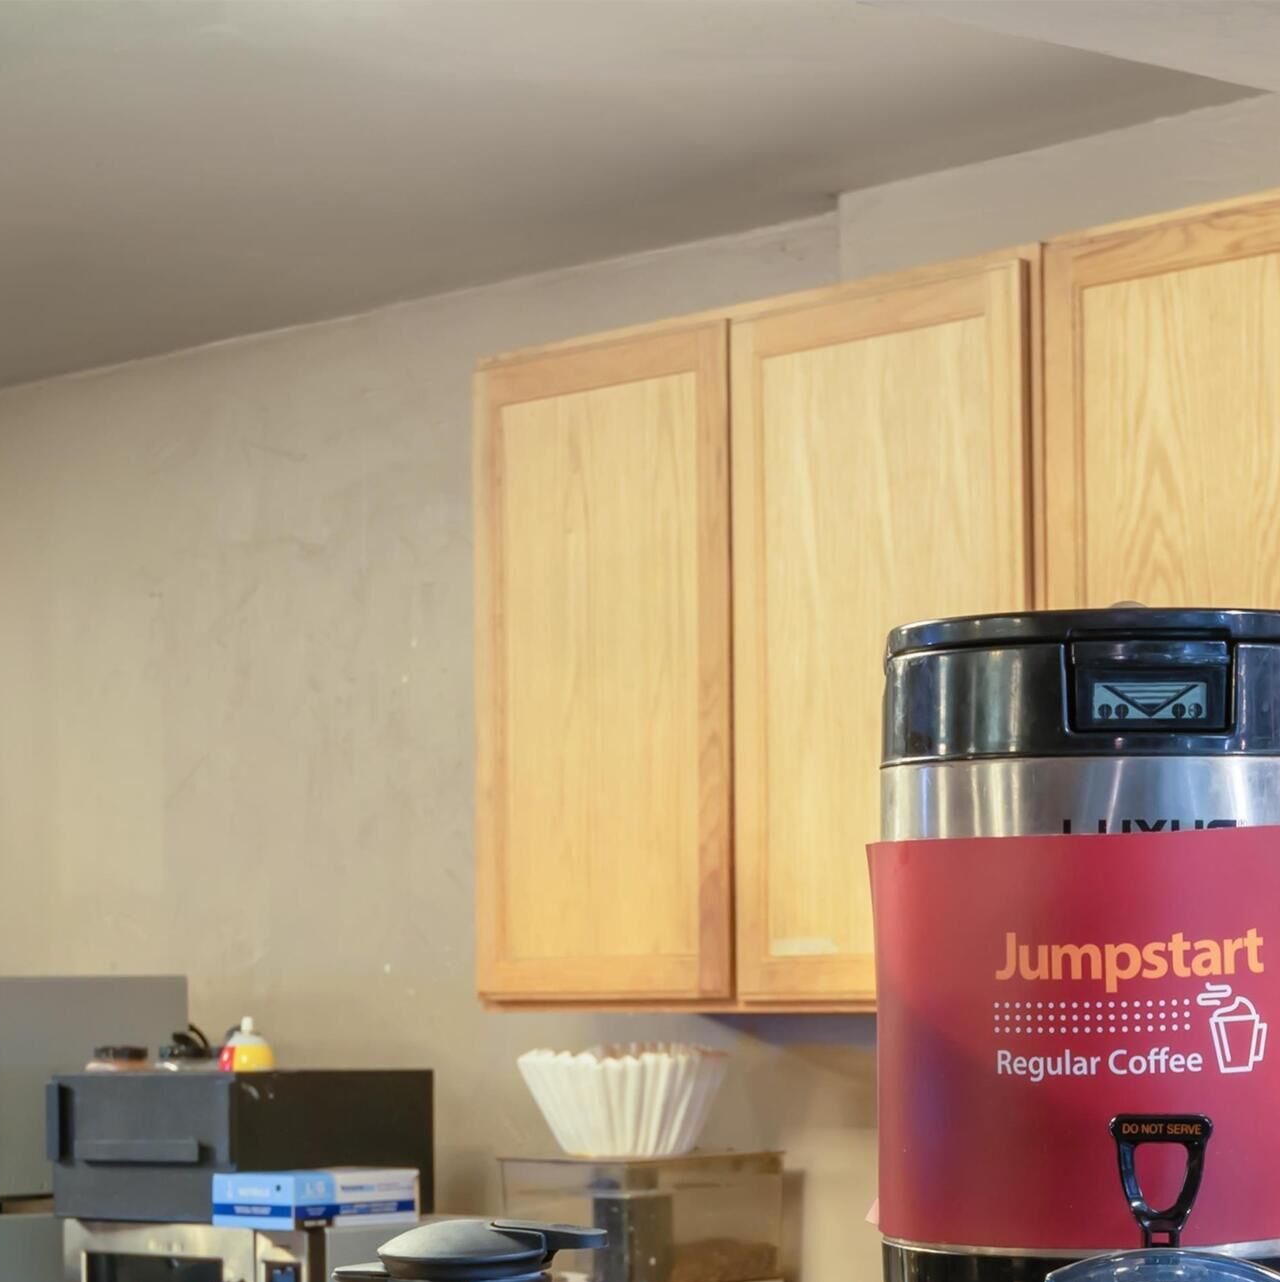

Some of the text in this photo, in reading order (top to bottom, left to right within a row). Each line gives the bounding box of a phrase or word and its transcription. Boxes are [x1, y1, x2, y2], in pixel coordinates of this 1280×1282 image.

[995, 927, 1264, 993] Jumpstart
[996, 1046, 1202, 1083] Regular Coffee
[1122, 1123, 1202, 1135] DO NOT SERVE
